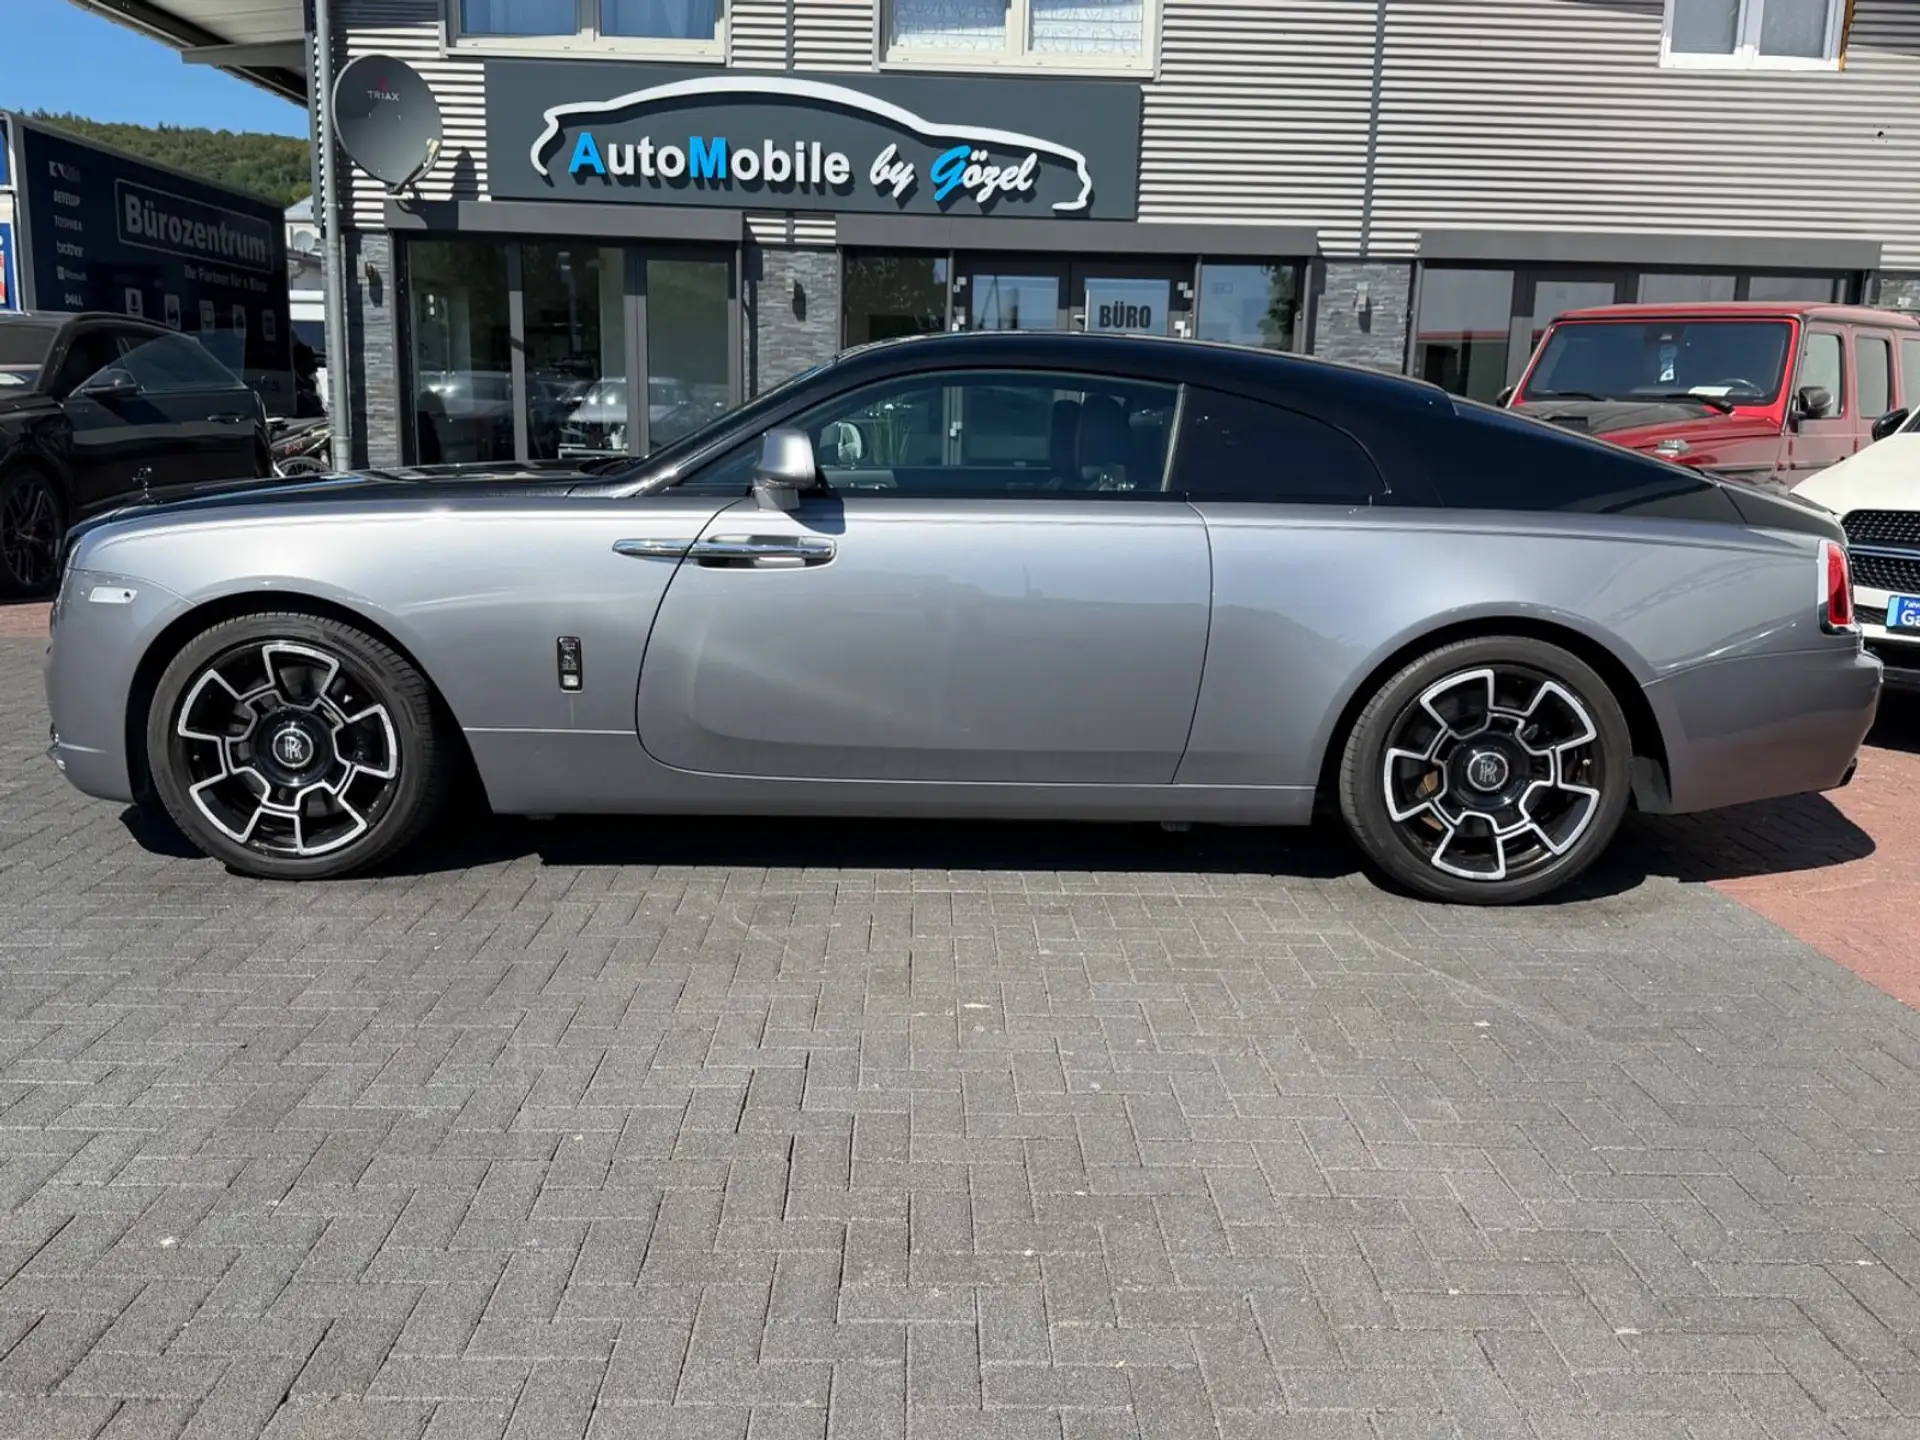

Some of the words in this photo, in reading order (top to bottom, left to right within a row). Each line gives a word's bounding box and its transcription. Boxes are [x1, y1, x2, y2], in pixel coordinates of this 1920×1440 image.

[366, 90, 400, 101] TRIAX
[568, 132, 850, 185] AutoMobile
[870, 143, 915, 197] by
[931, 146, 1038, 202] Gözel
[125, 194, 266, 262] Bürozentrum
[1099, 301, 1152, 329] BÜRO
